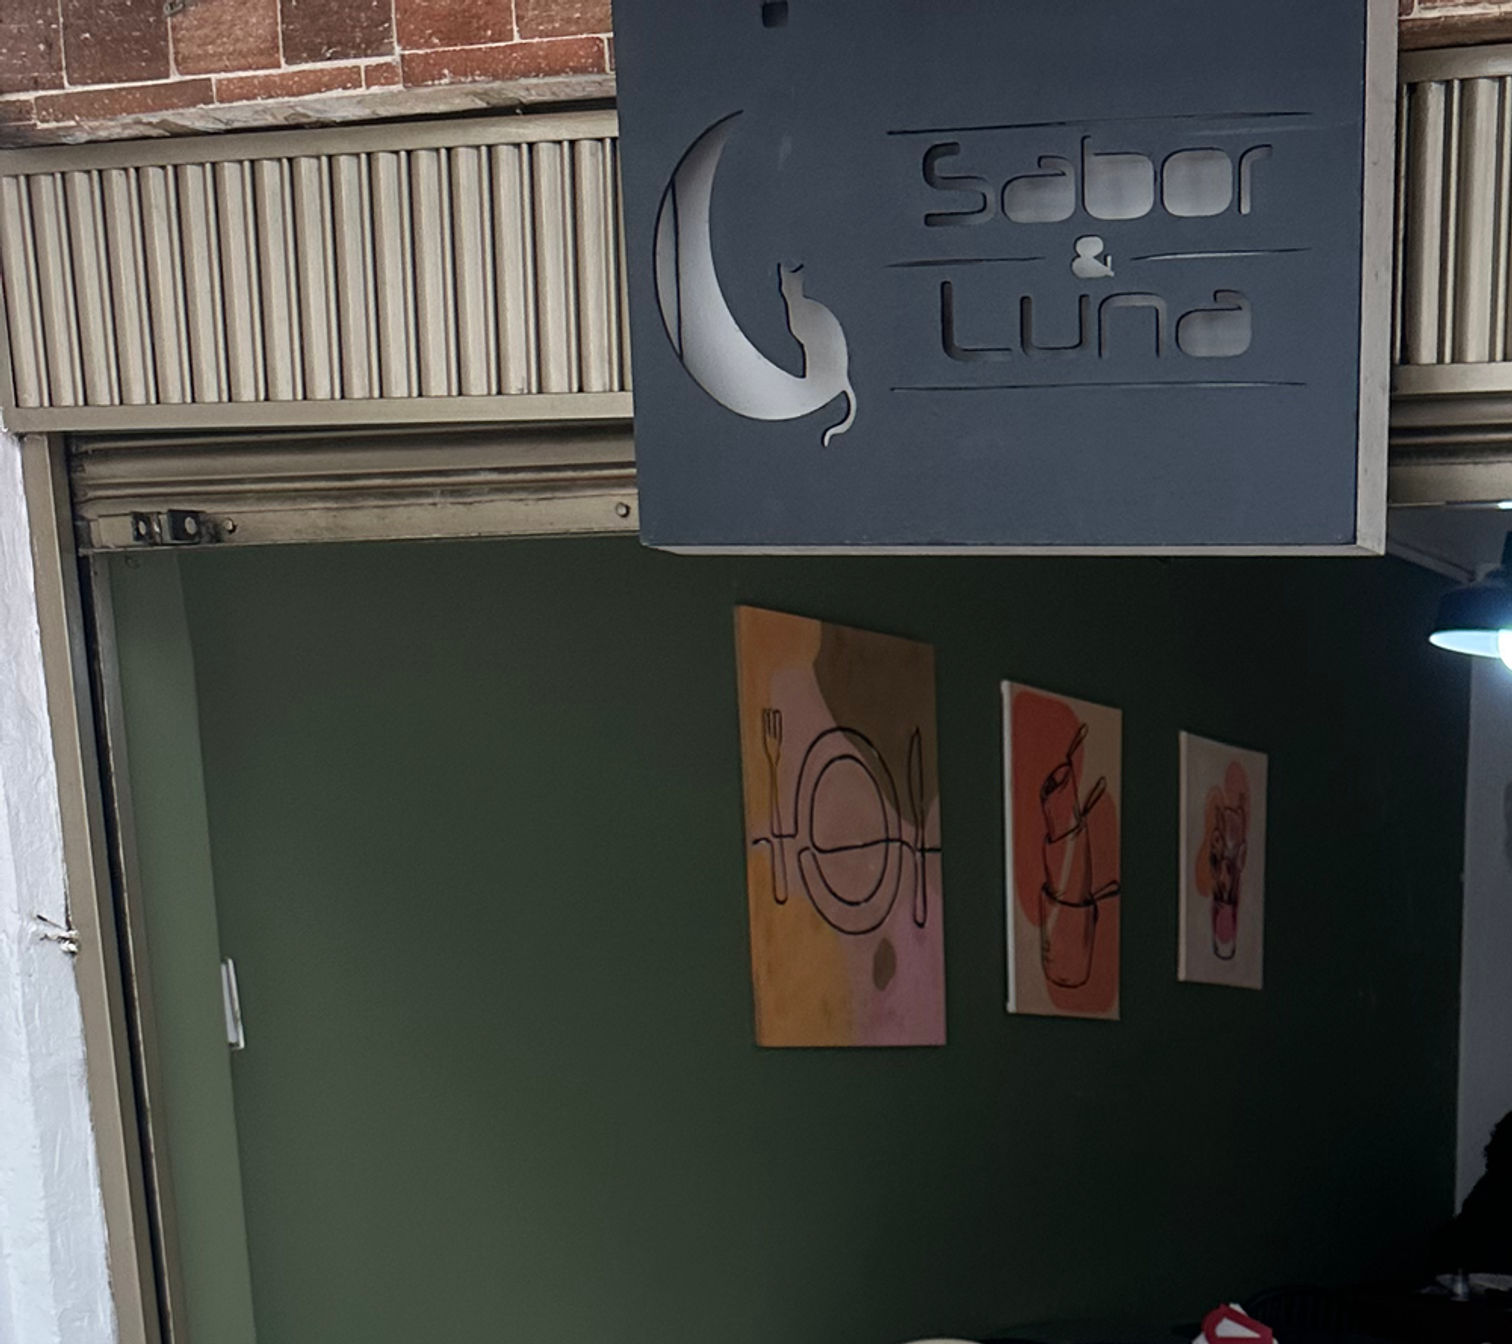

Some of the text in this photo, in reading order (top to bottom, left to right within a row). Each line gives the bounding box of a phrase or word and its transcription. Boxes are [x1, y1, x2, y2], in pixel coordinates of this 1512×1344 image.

[921, 135, 1273, 228] Sabor
[1070, 234, 1116, 280] &
[939, 280, 1252, 363] Luna
